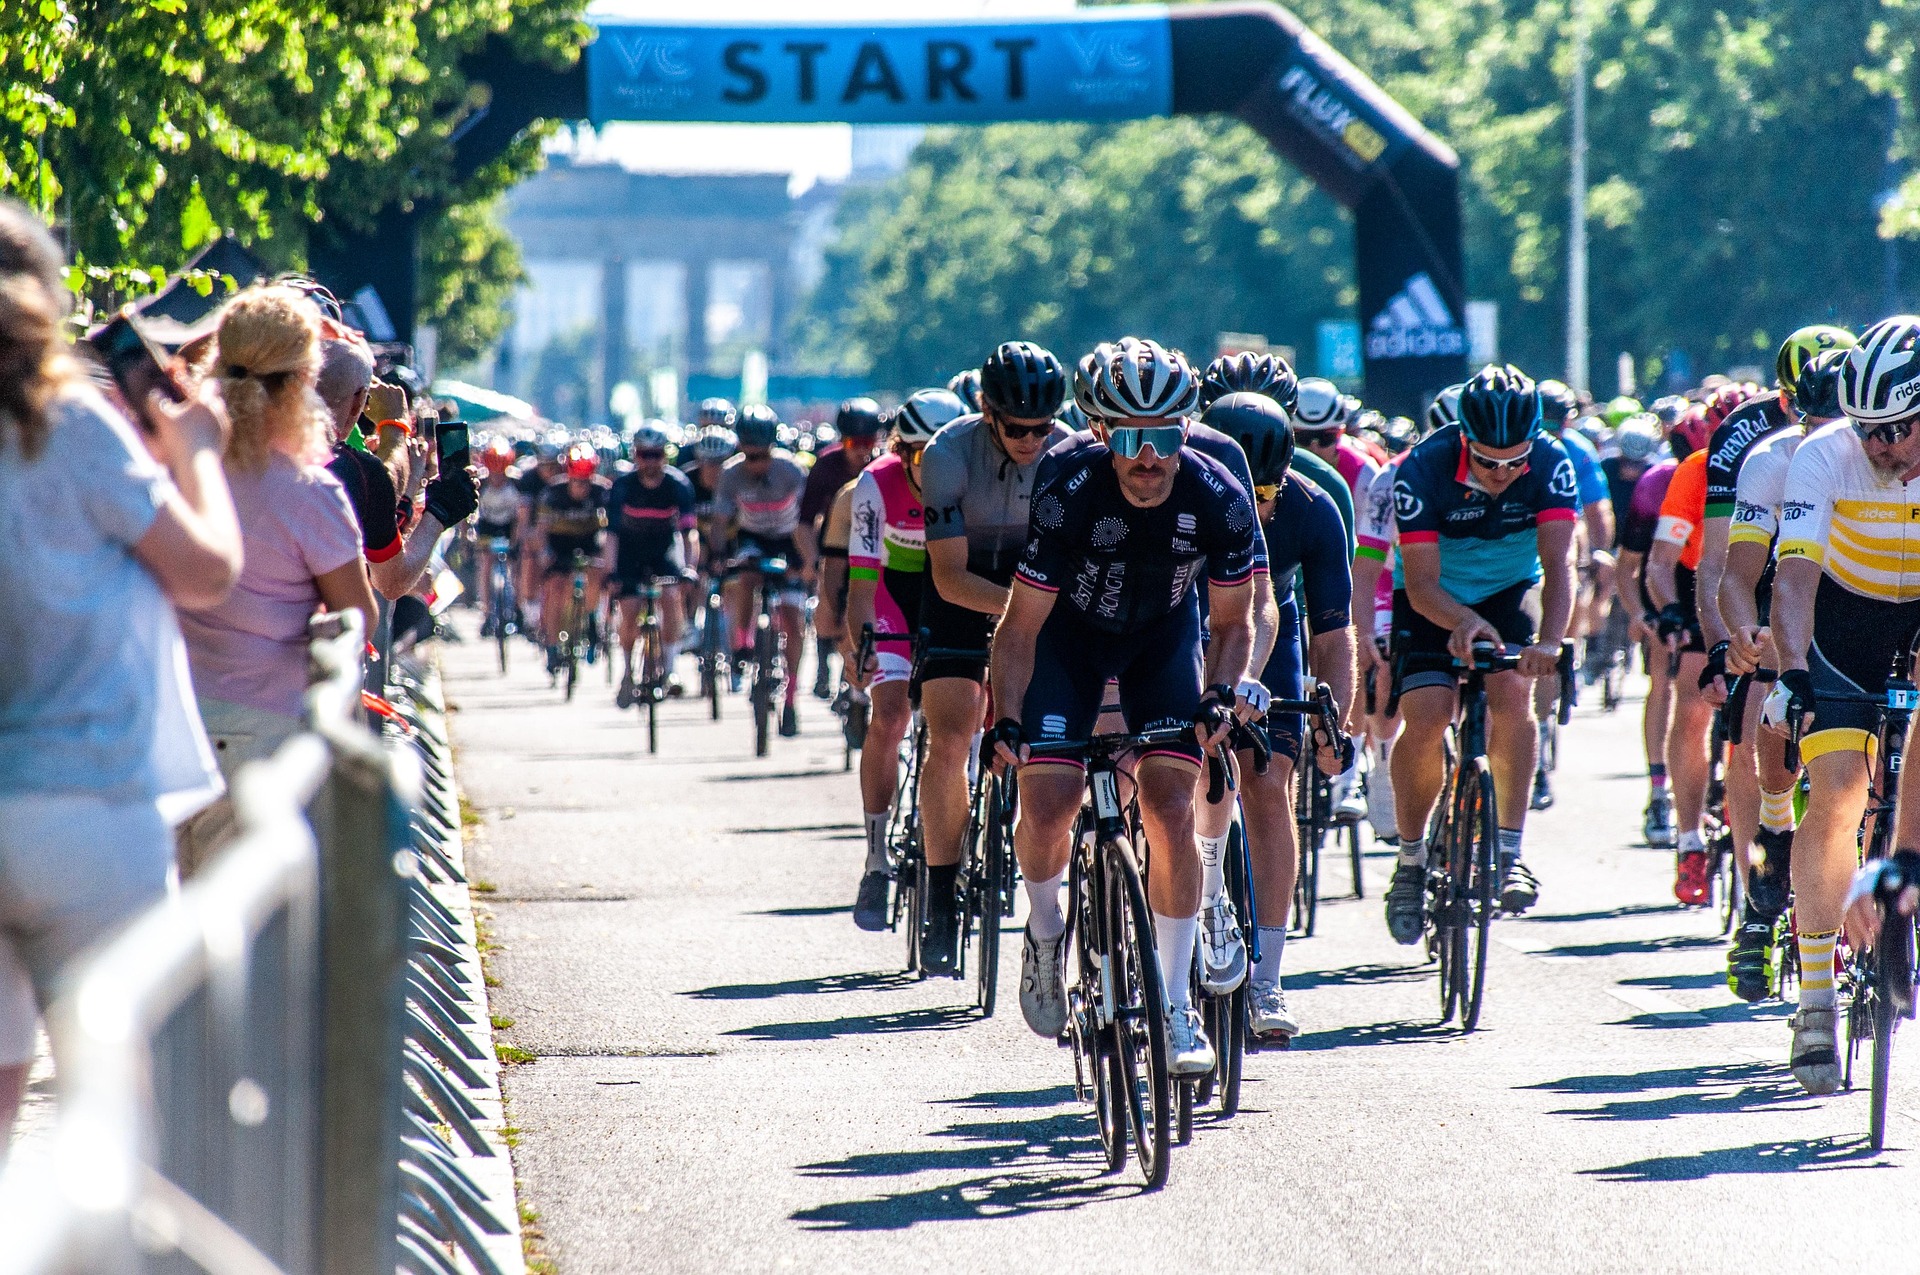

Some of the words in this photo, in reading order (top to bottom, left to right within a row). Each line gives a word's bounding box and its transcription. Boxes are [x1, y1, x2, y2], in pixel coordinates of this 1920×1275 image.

[721, 37, 1036, 105] START
[1367, 324, 1462, 358] adidas
[1068, 469, 1089, 490] CLIF
[1203, 471, 1225, 493] CLIF
[1018, 561, 1047, 581] ahoo
[1898, 693, 1906, 703] T
